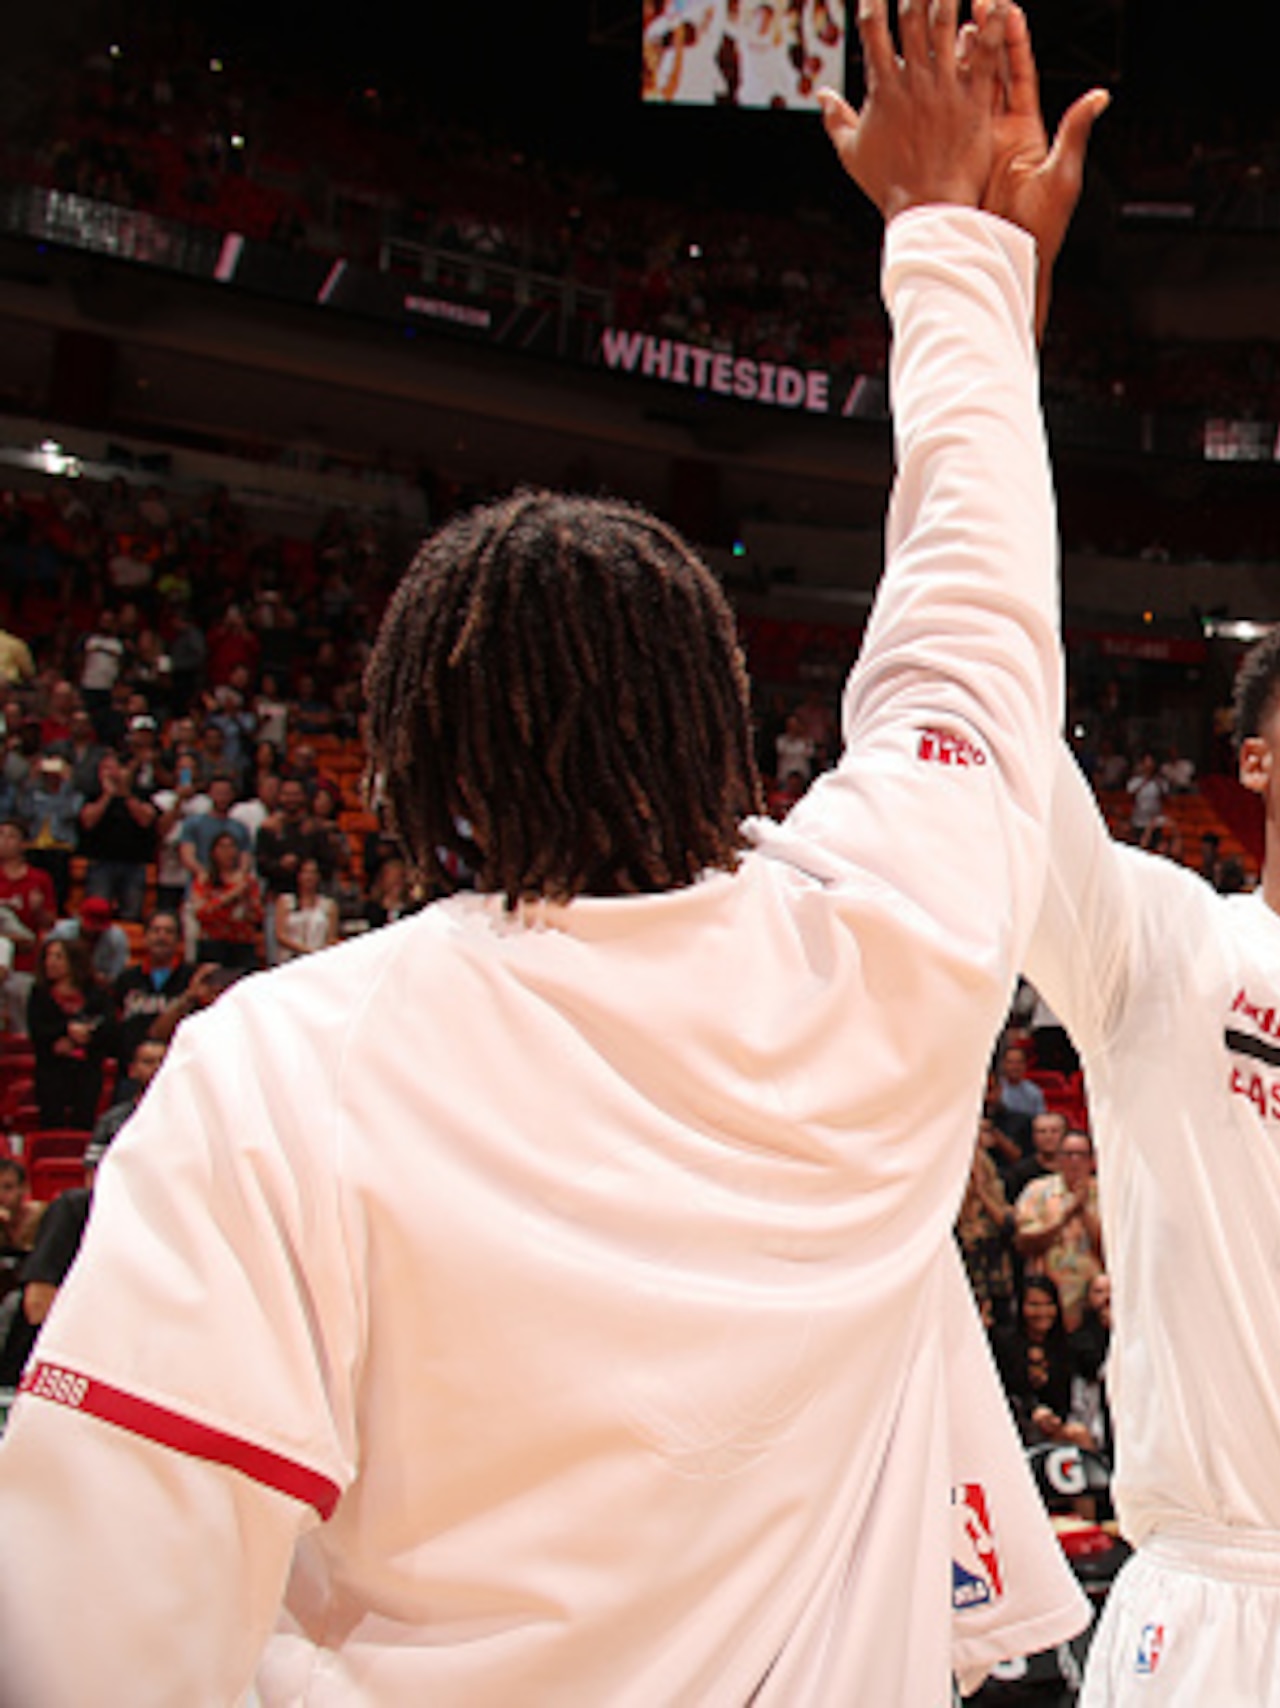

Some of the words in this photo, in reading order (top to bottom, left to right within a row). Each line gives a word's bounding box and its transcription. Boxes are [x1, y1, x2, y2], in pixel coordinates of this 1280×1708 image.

[602, 327, 829, 411] WHITESIDE
[34, 1365, 89, 1408] 1988
[1046, 1446, 1088, 1495] G
